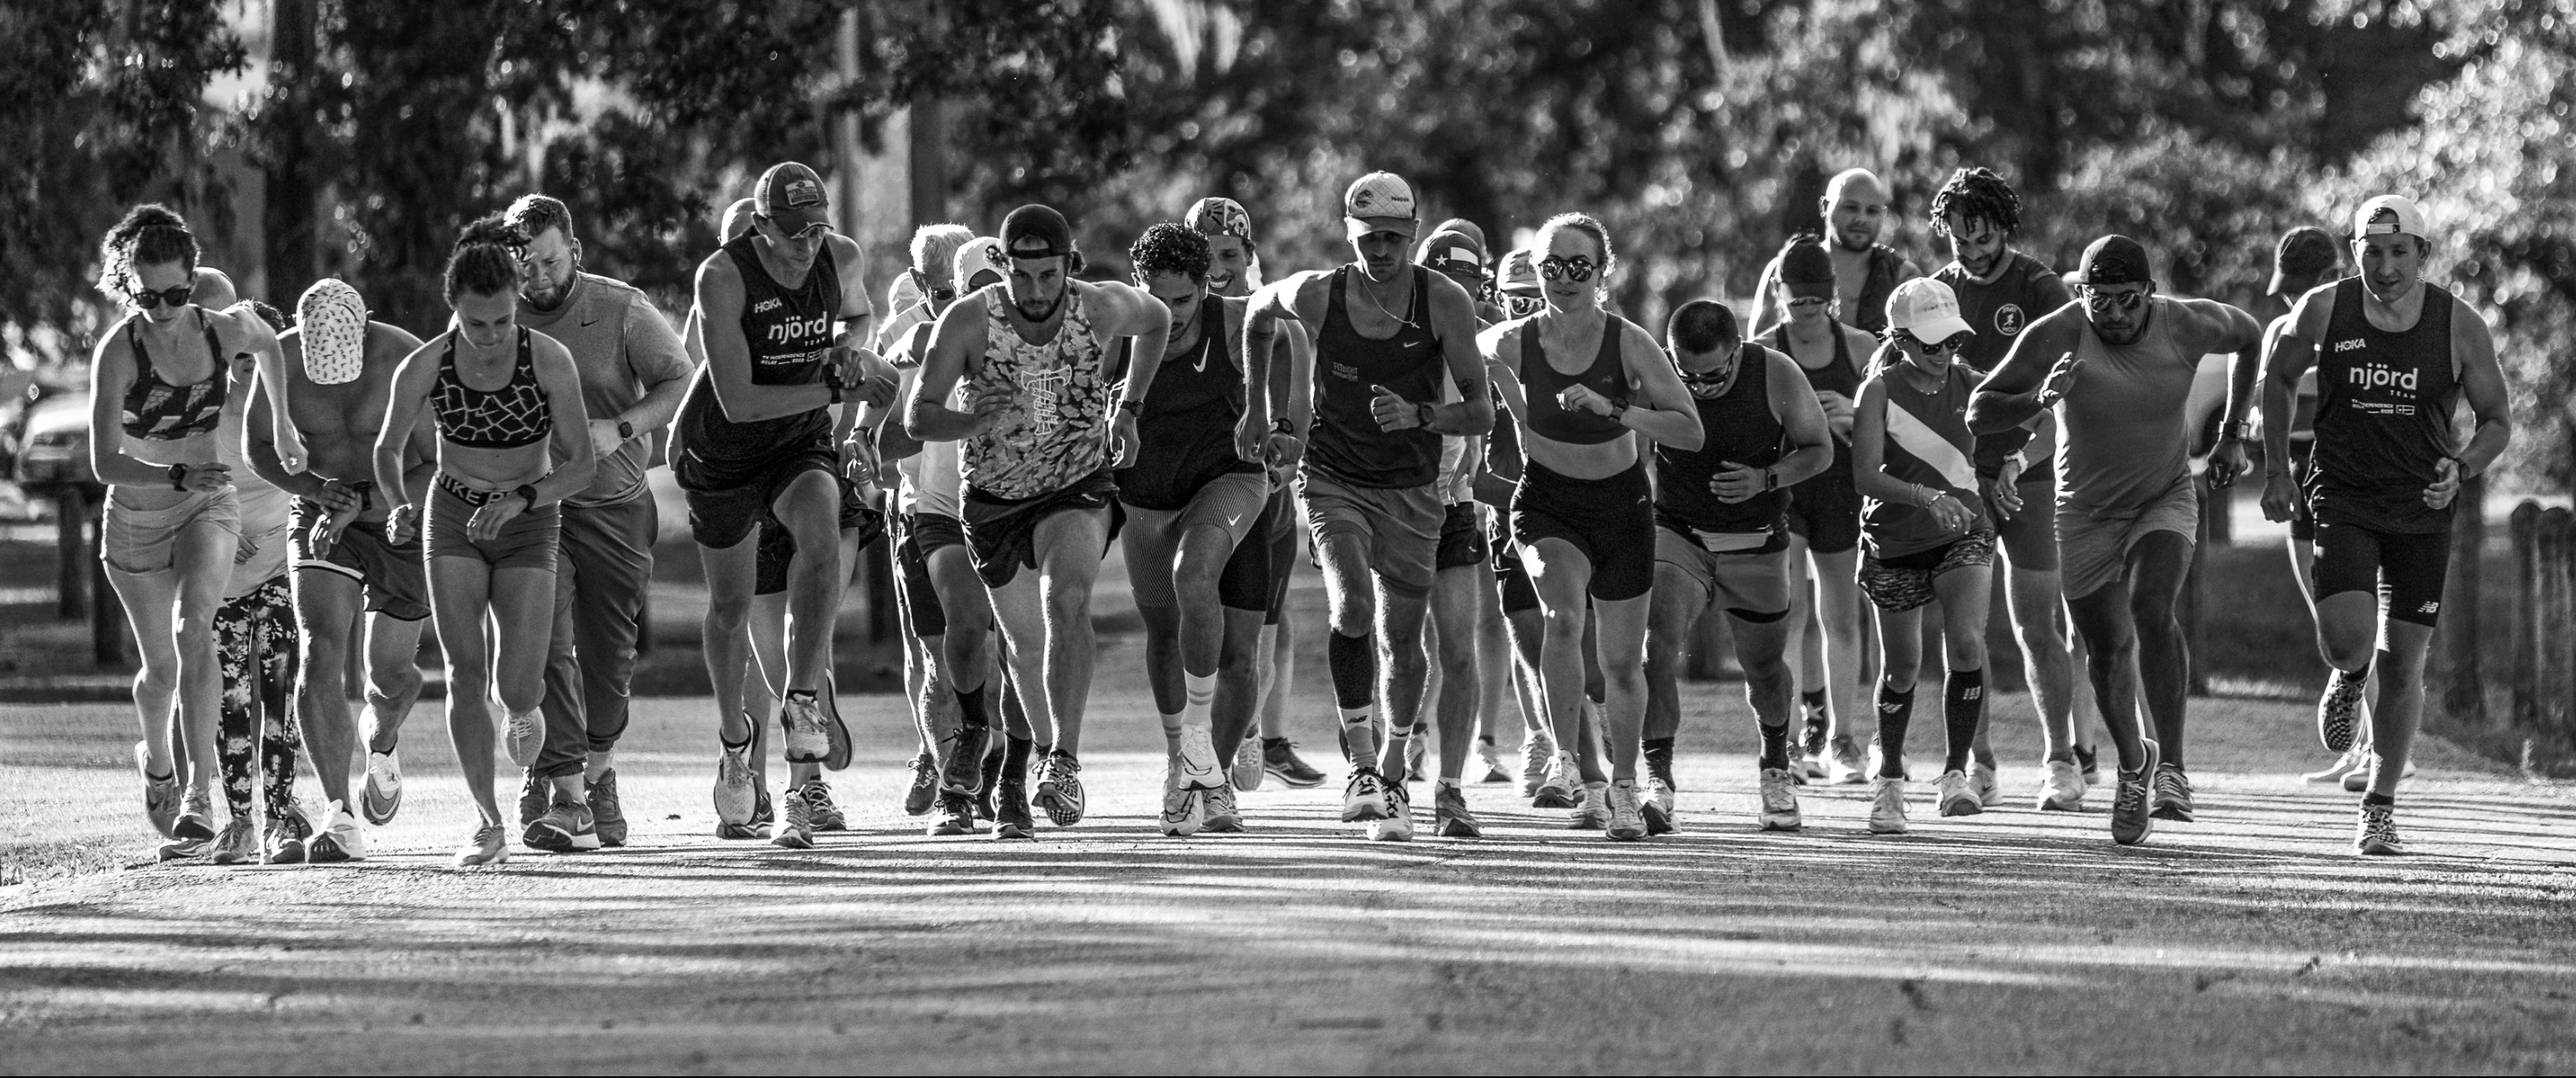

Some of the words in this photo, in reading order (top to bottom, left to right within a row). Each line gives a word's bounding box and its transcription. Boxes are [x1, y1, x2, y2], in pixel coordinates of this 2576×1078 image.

[1512, 260, 1535, 276] cie
[755, 298, 782, 313] HOKA
[768, 310, 828, 344] njörd
[2335, 338, 2367, 353] HOKA
[2349, 362, 2418, 391] njörd
[2390, 390, 2417, 399] TEAM
[438, 472, 479, 505] NIKE
